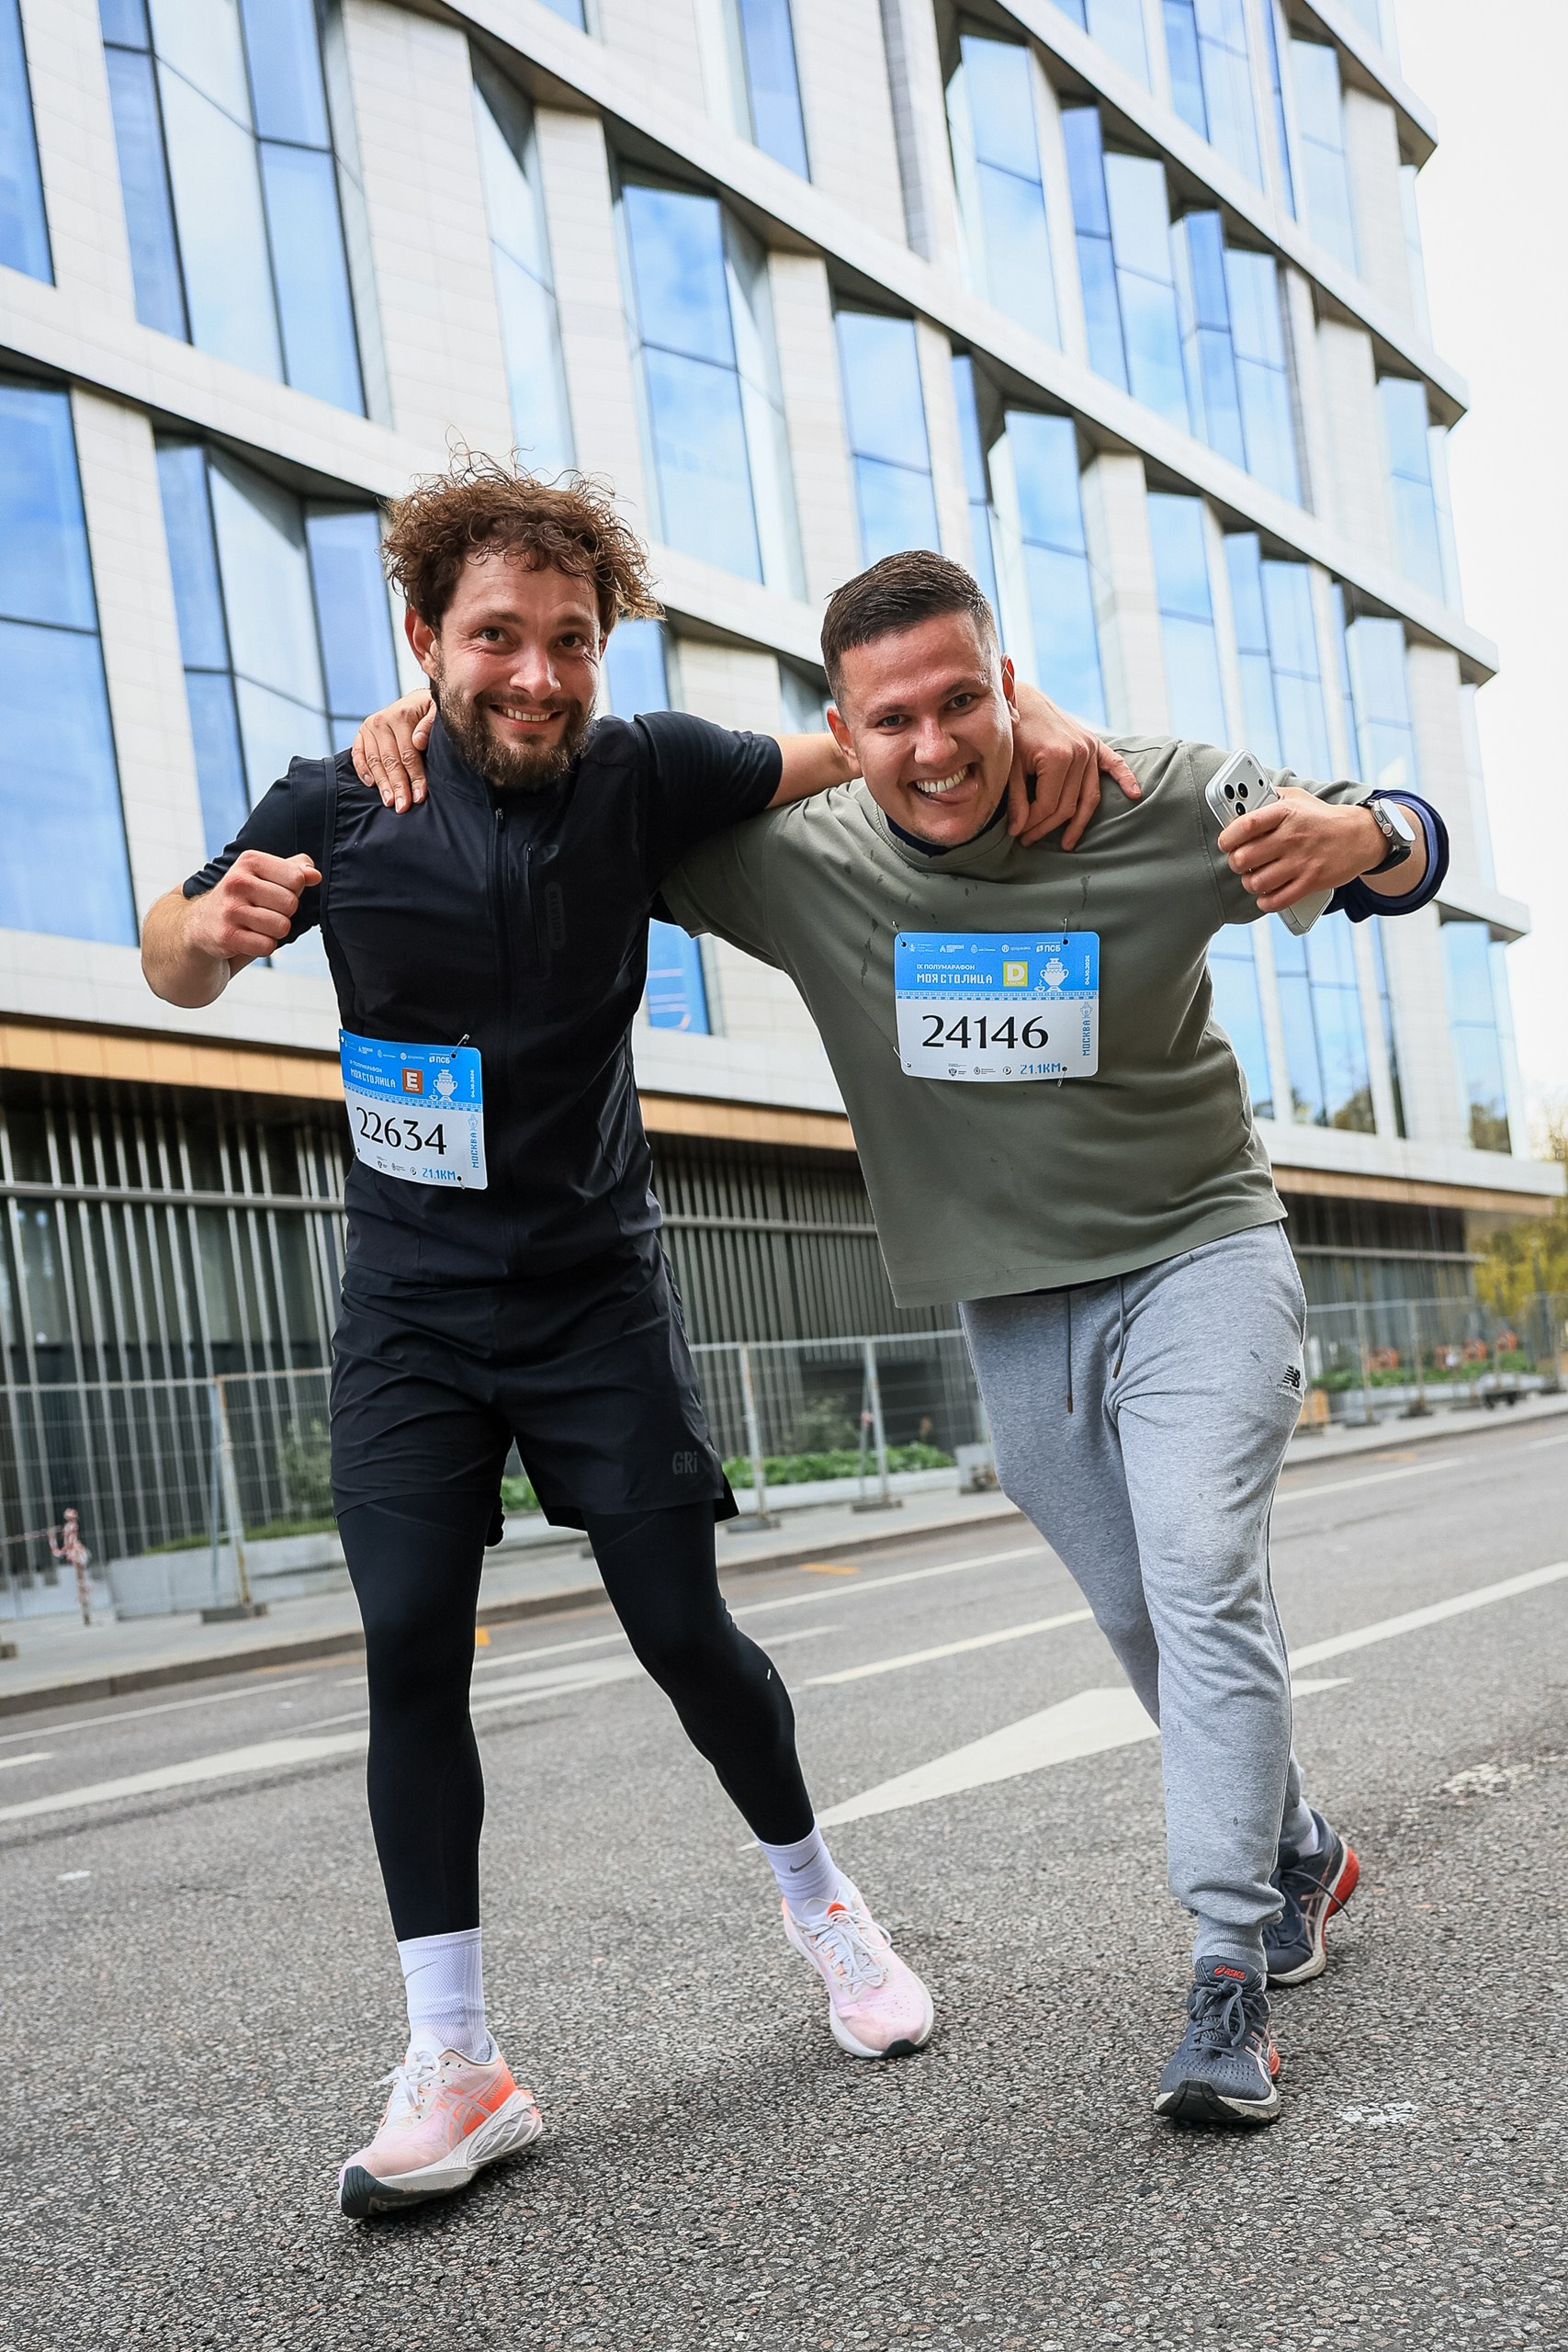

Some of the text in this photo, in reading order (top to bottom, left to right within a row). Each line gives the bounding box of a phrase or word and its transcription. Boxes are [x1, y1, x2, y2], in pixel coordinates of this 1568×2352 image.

[917, 973, 992, 984] МОЯ СТОЛИЦА
[1007, 964, 1025, 981] D
[921, 1014, 1049, 1049] 24146
[1082, 1020, 1090, 1057] МОСКВА
[362, 1072, 396, 1088] СТОЛИЦА
[356, 1107, 447, 1156] 22634
[470, 1132, 479, 1168] МОСКВА
[671, 1451, 698, 1476] GRi
